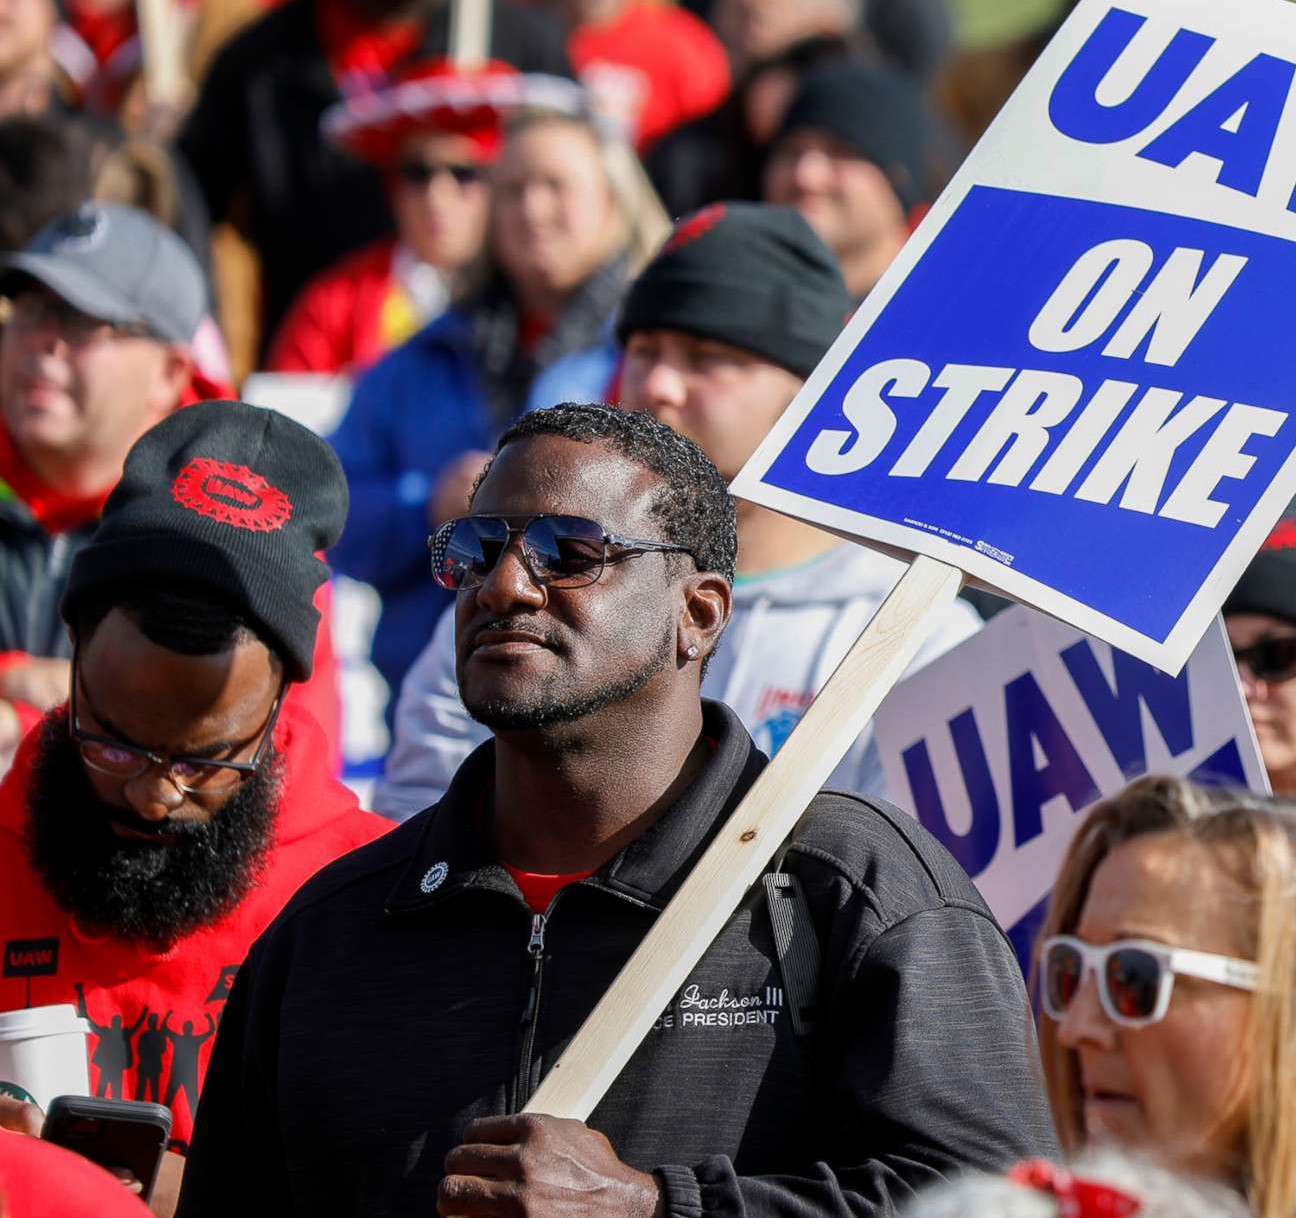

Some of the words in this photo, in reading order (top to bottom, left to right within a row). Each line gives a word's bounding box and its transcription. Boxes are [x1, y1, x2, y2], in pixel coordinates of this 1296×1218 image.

[1028, 239, 1249, 367] ON
[805, 358, 1289, 528] STRIKE
[902, 638, 1194, 881] UAW
[9, 951, 50, 966] UAW
[680, 984, 762, 1009] Jackson
[766, 986, 783, 1006] III
[682, 1010, 780, 1027] PRESIDENT
